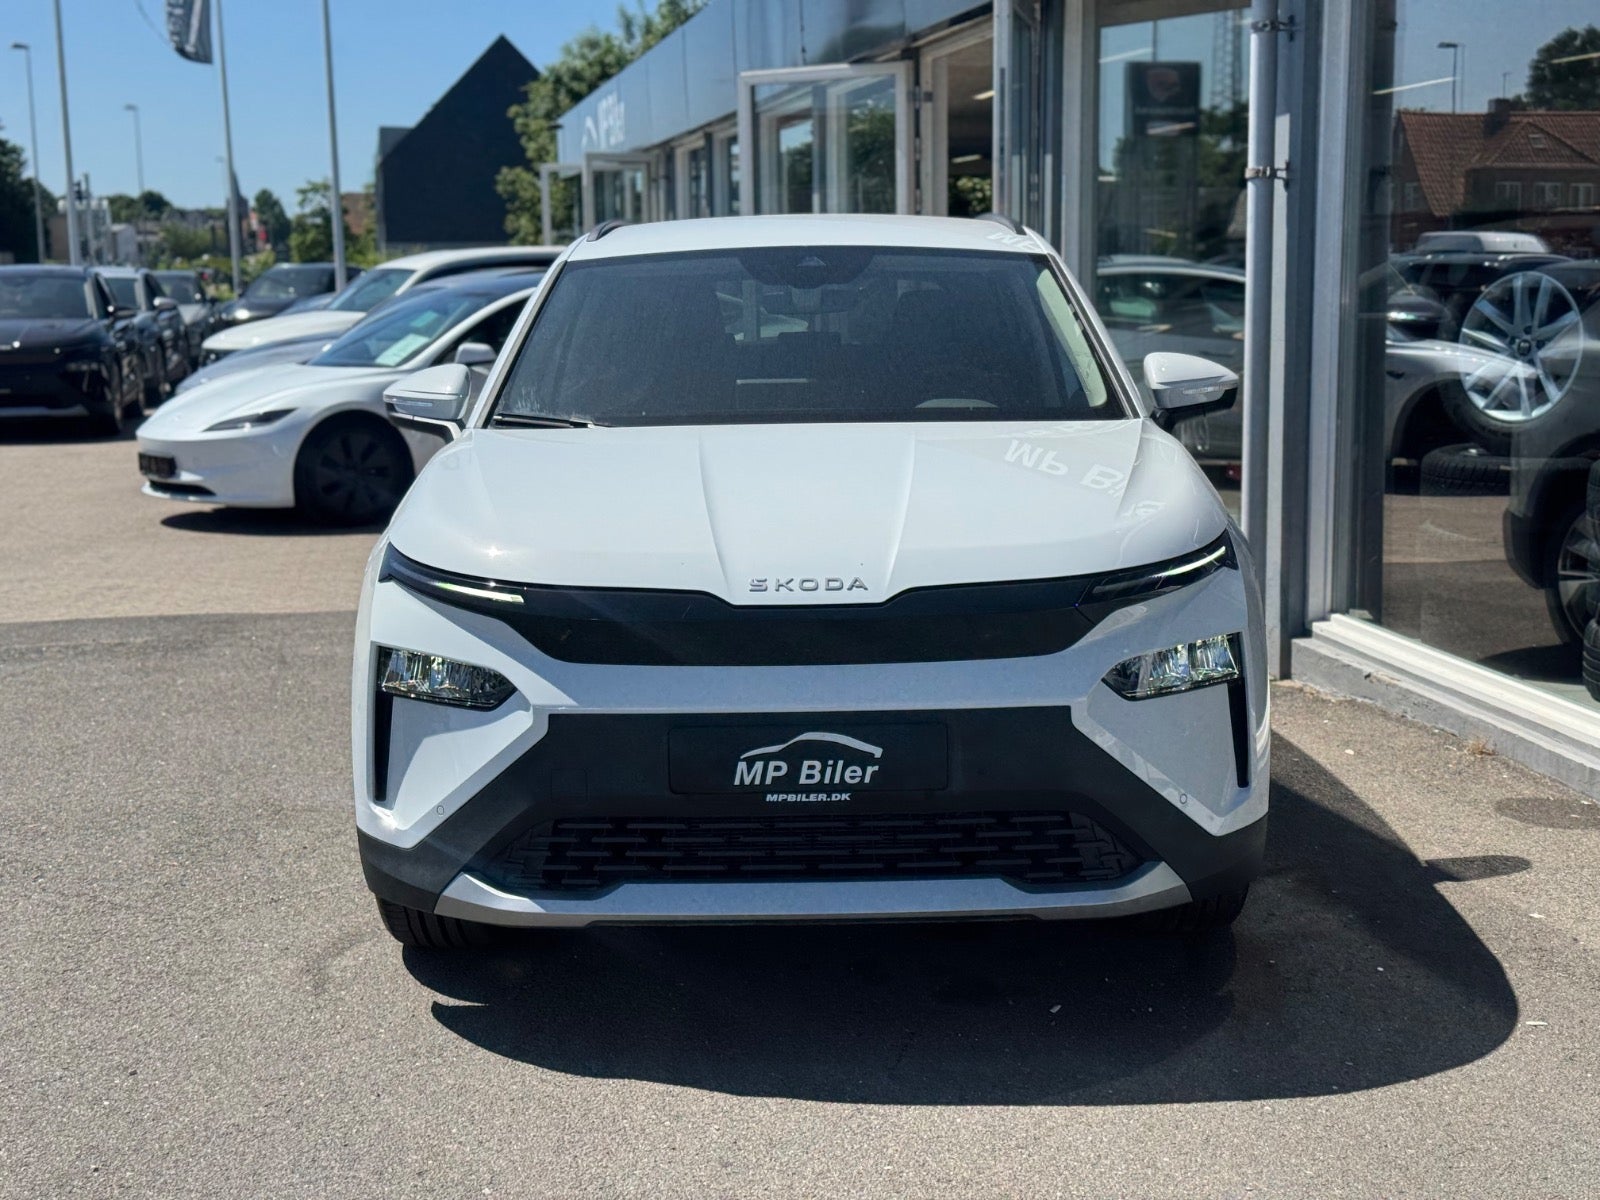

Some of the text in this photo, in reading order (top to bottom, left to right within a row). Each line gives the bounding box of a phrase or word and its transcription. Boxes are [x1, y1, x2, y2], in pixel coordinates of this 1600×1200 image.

[733, 759, 880, 786] MP Biler
[765, 792, 852, 802] MPBILER.DK
